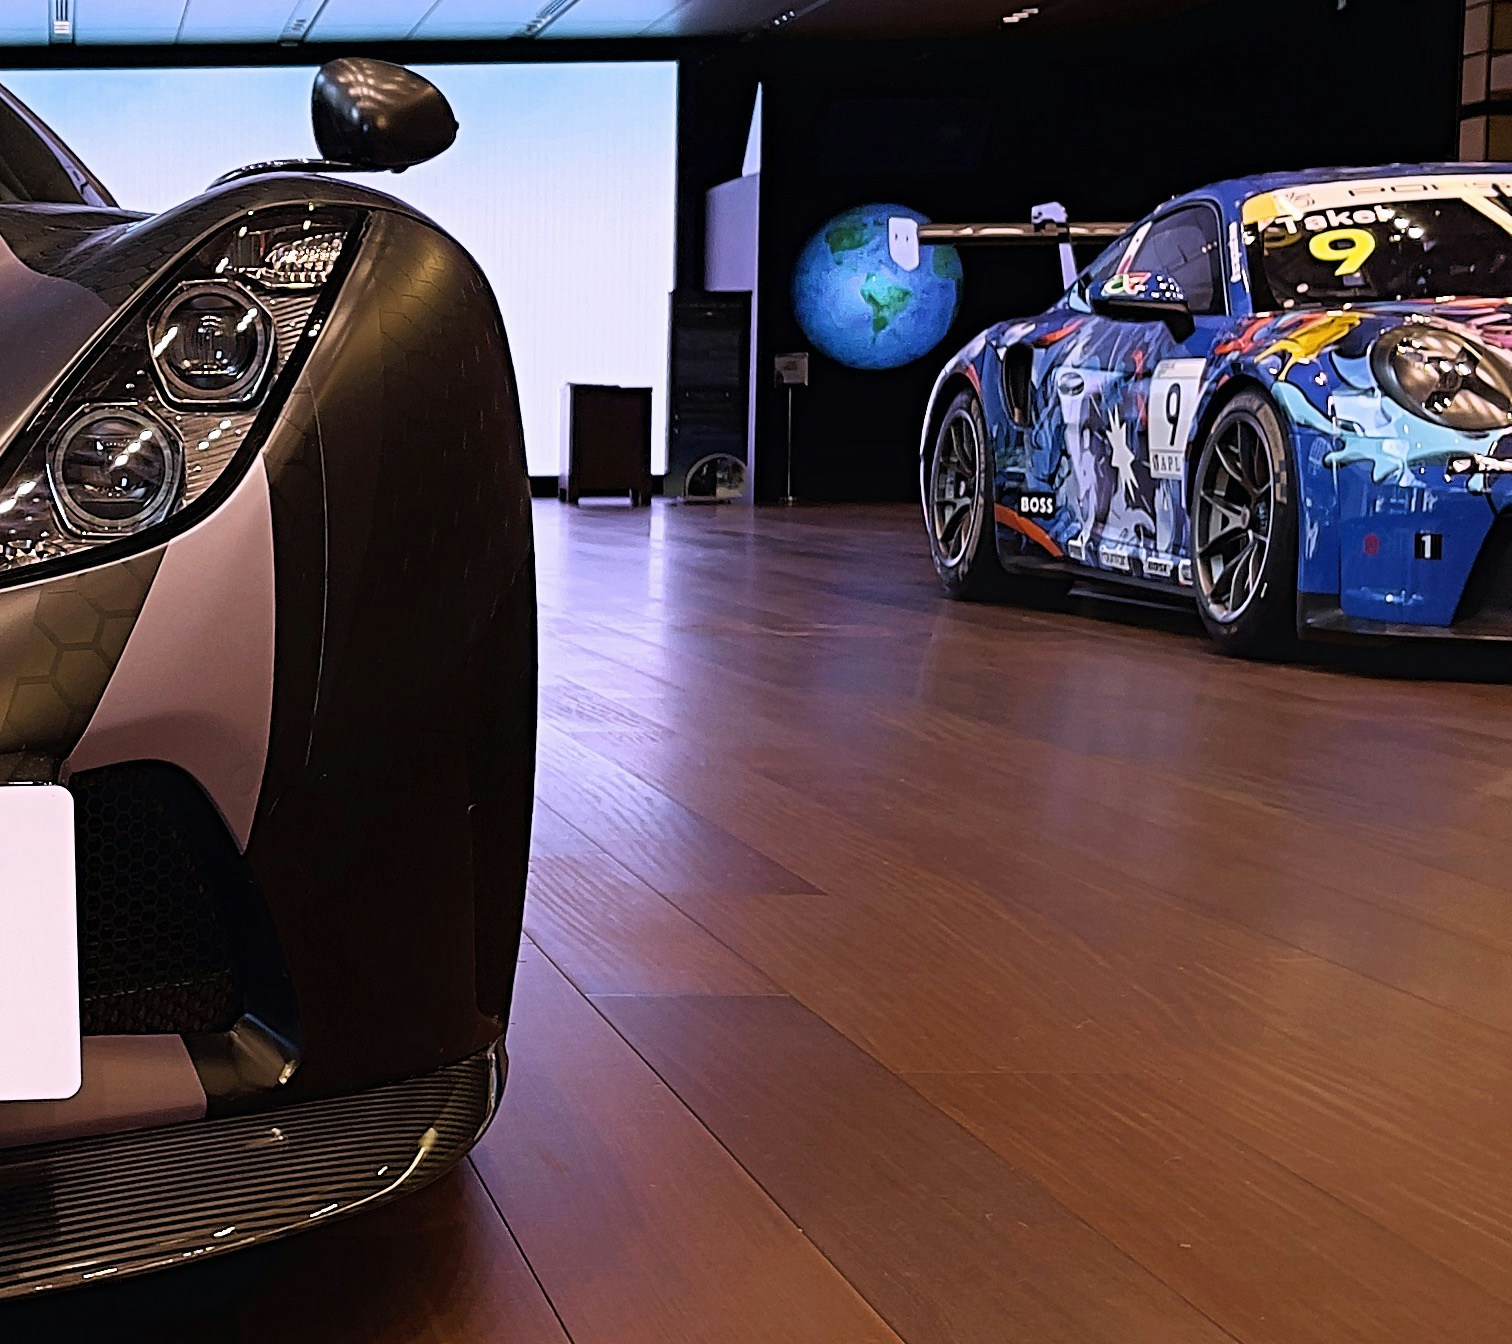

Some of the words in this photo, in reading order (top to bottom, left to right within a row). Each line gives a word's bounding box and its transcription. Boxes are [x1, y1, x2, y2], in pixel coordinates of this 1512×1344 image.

[1308, 228, 1376, 276] 9
[1166, 382, 1182, 446] 9
[1020, 496, 1053, 514] BOSS
